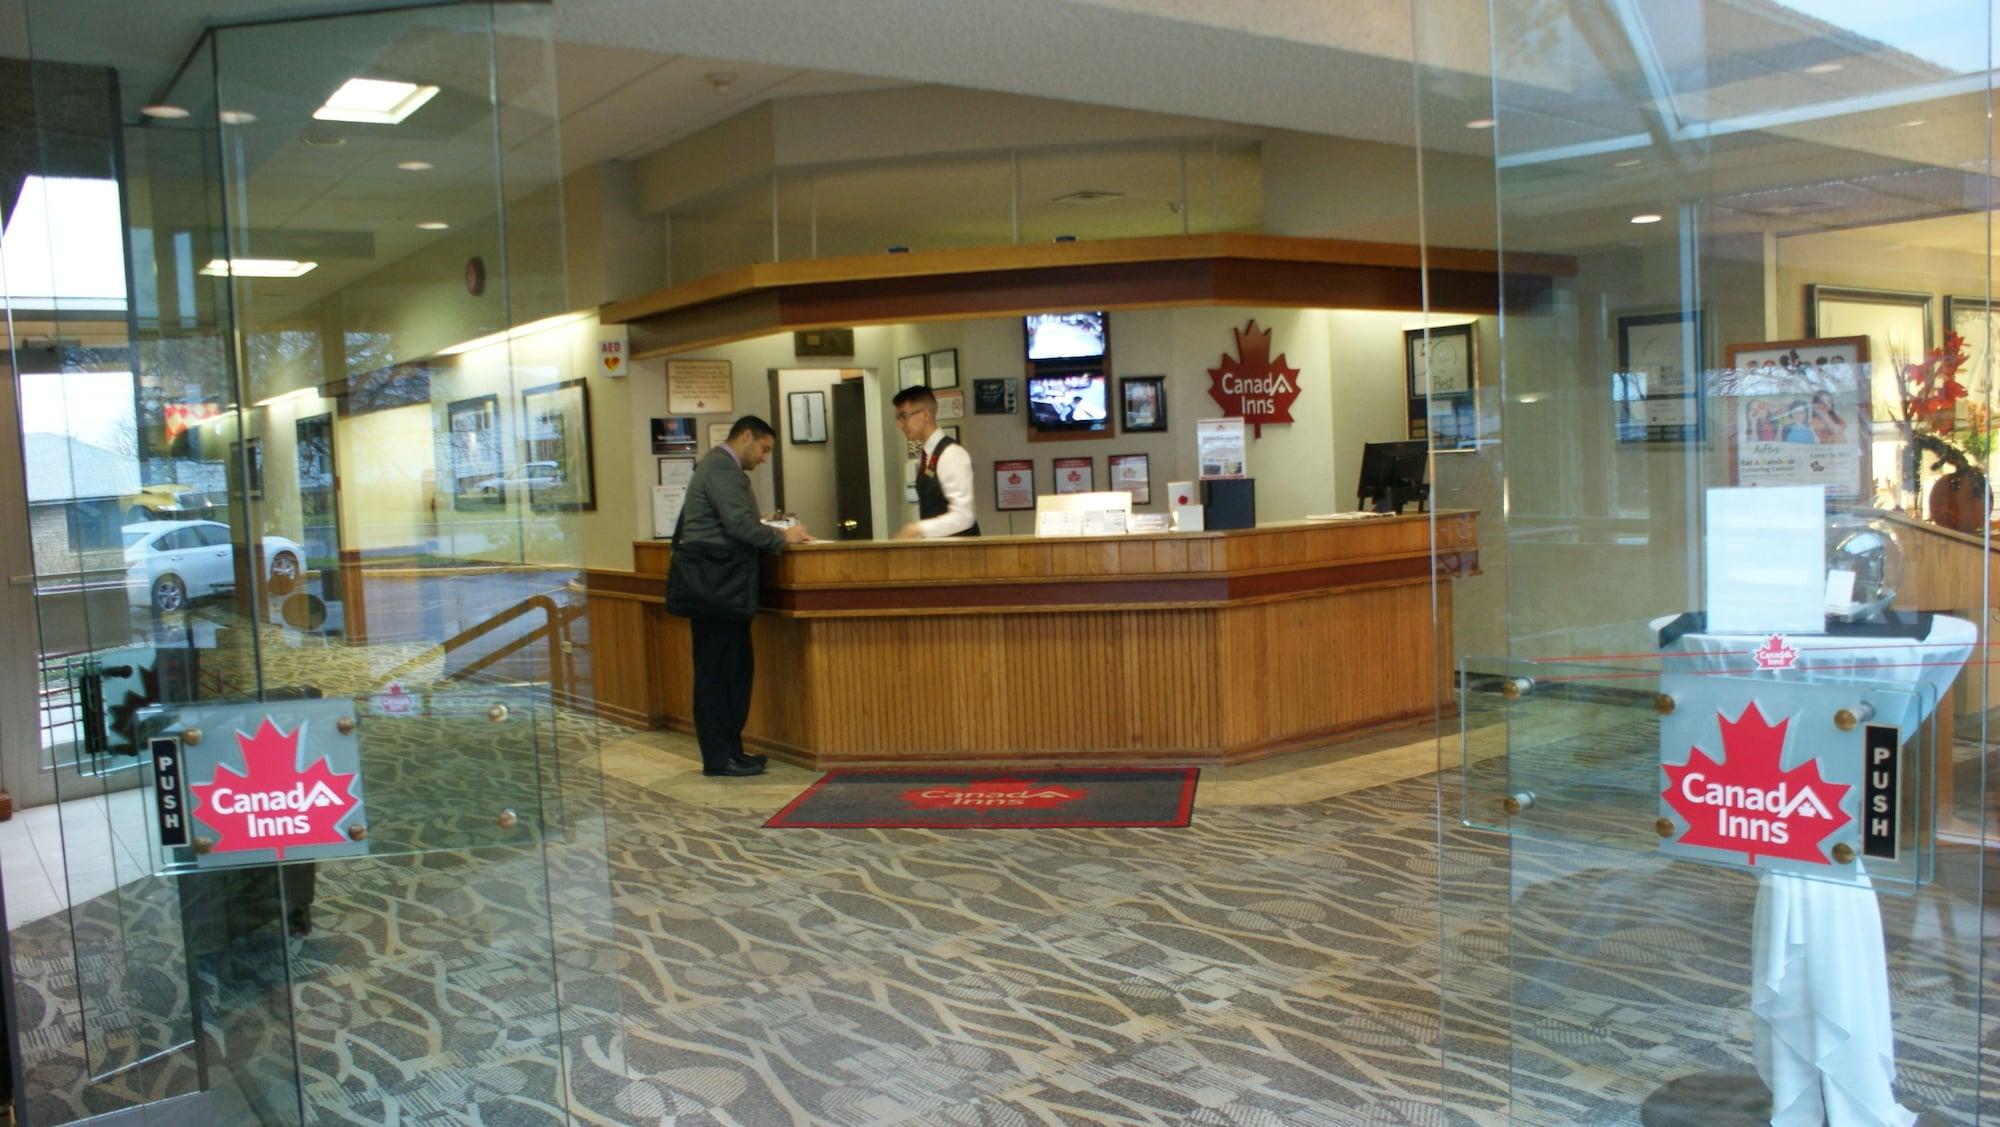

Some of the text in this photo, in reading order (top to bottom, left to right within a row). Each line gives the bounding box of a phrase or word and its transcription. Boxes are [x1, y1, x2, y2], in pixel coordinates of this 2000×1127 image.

[601, 342, 621, 352] AED
[1241, 395, 1275, 415] Inns
[158, 756, 180, 829] PUSH
[952, 798, 1025, 806] Inns
[1871, 747, 1891, 838] PUSH
[247, 812, 312, 838] Inns
[1717, 808, 1790, 845] Inns
